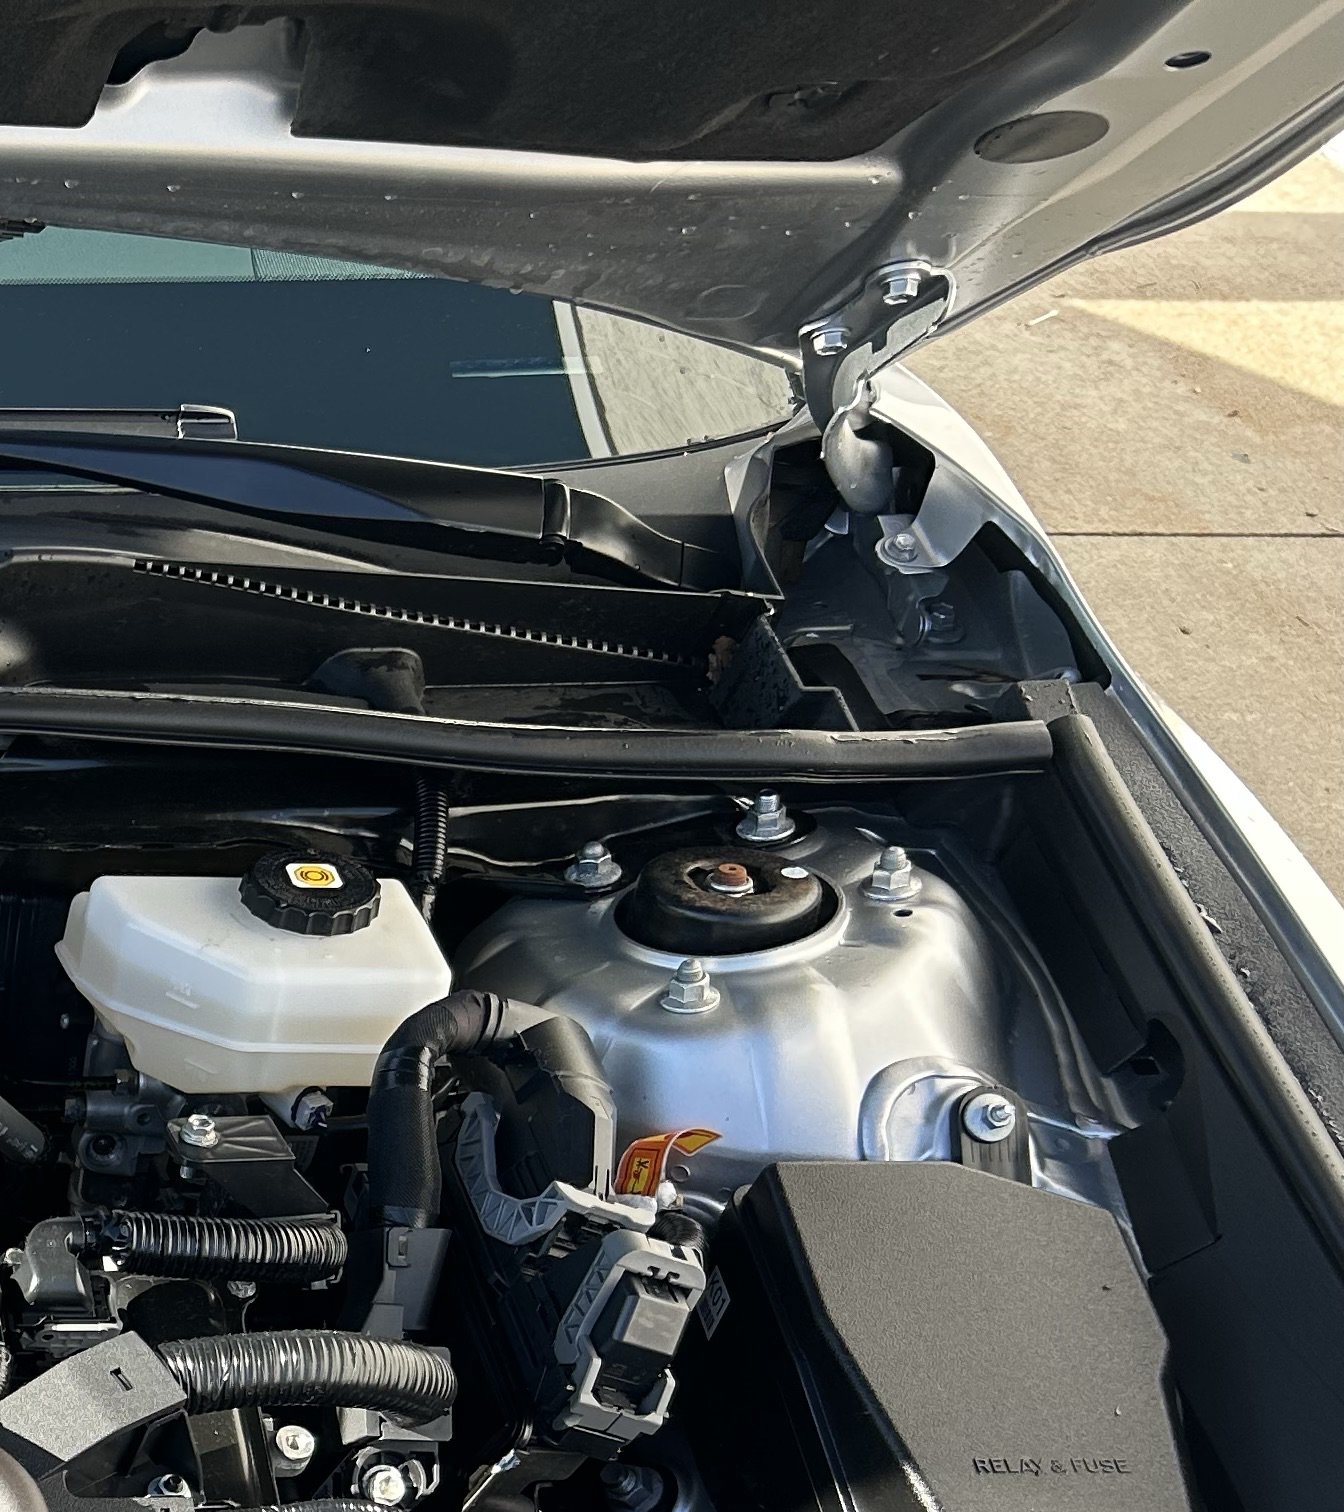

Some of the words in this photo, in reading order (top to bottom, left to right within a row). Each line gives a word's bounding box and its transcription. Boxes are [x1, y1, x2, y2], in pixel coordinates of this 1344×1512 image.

[972, 1457, 1043, 1476] RELAY
[1050, 1458, 1068, 1475] &
[1070, 1457, 1132, 1475] FUSE
